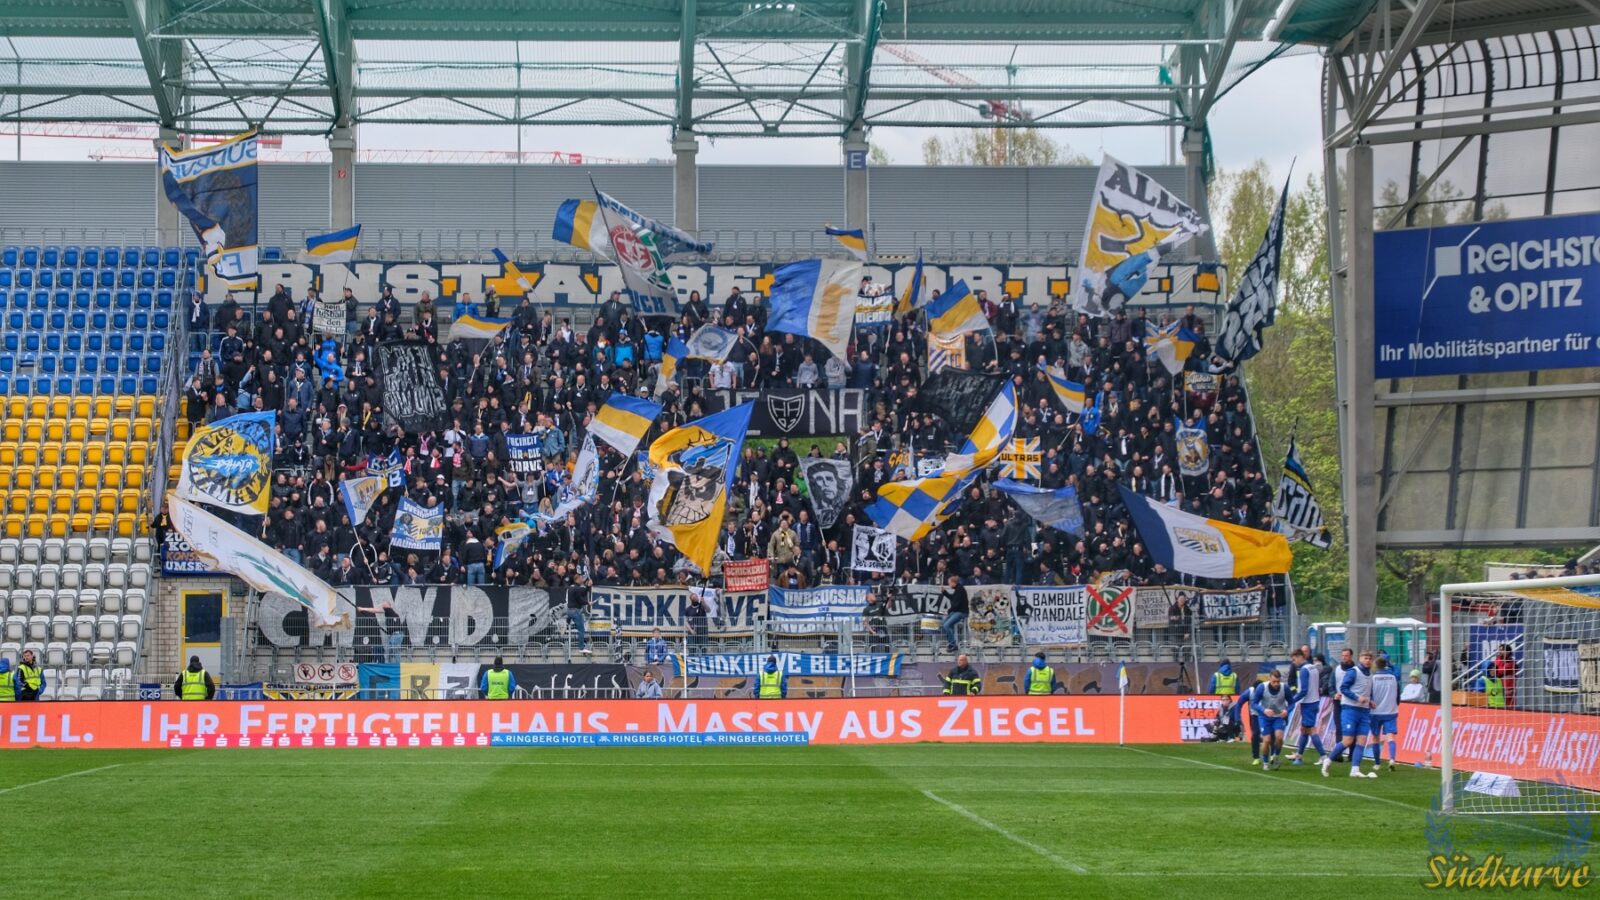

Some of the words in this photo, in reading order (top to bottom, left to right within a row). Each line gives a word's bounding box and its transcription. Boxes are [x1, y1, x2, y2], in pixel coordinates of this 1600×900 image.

[850, 153, 863, 169] E
[1468, 286, 1491, 314] &
[1494, 278, 1583, 312] OPITZ
[1380, 344, 1404, 361] Ihr
[1408, 337, 1560, 360] Mobilitätspartner
[1564, 332, 1591, 351] für
[1001, 453, 1040, 462] ULTRAS
[1033, 591, 1084, 607] BAMBULE
[1034, 606, 1085, 623] RANDALE
[809, 654, 887, 674] BLEIBT
[0, 714, 94, 743] ELL.
[141, 704, 219, 742] IHR
[839, 709, 922, 739] AUS
[937, 699, 1095, 737] ZIEGEL
[505, 734, 560, 744] RINGBERG
[561, 734, 596, 744] HOTEL
[613, 734, 667, 744] RINGBERG
[669, 734, 703, 744] HOTEL
[718, 733, 772, 744] RINGBERG
[774, 733, 808, 743] HOTEL
